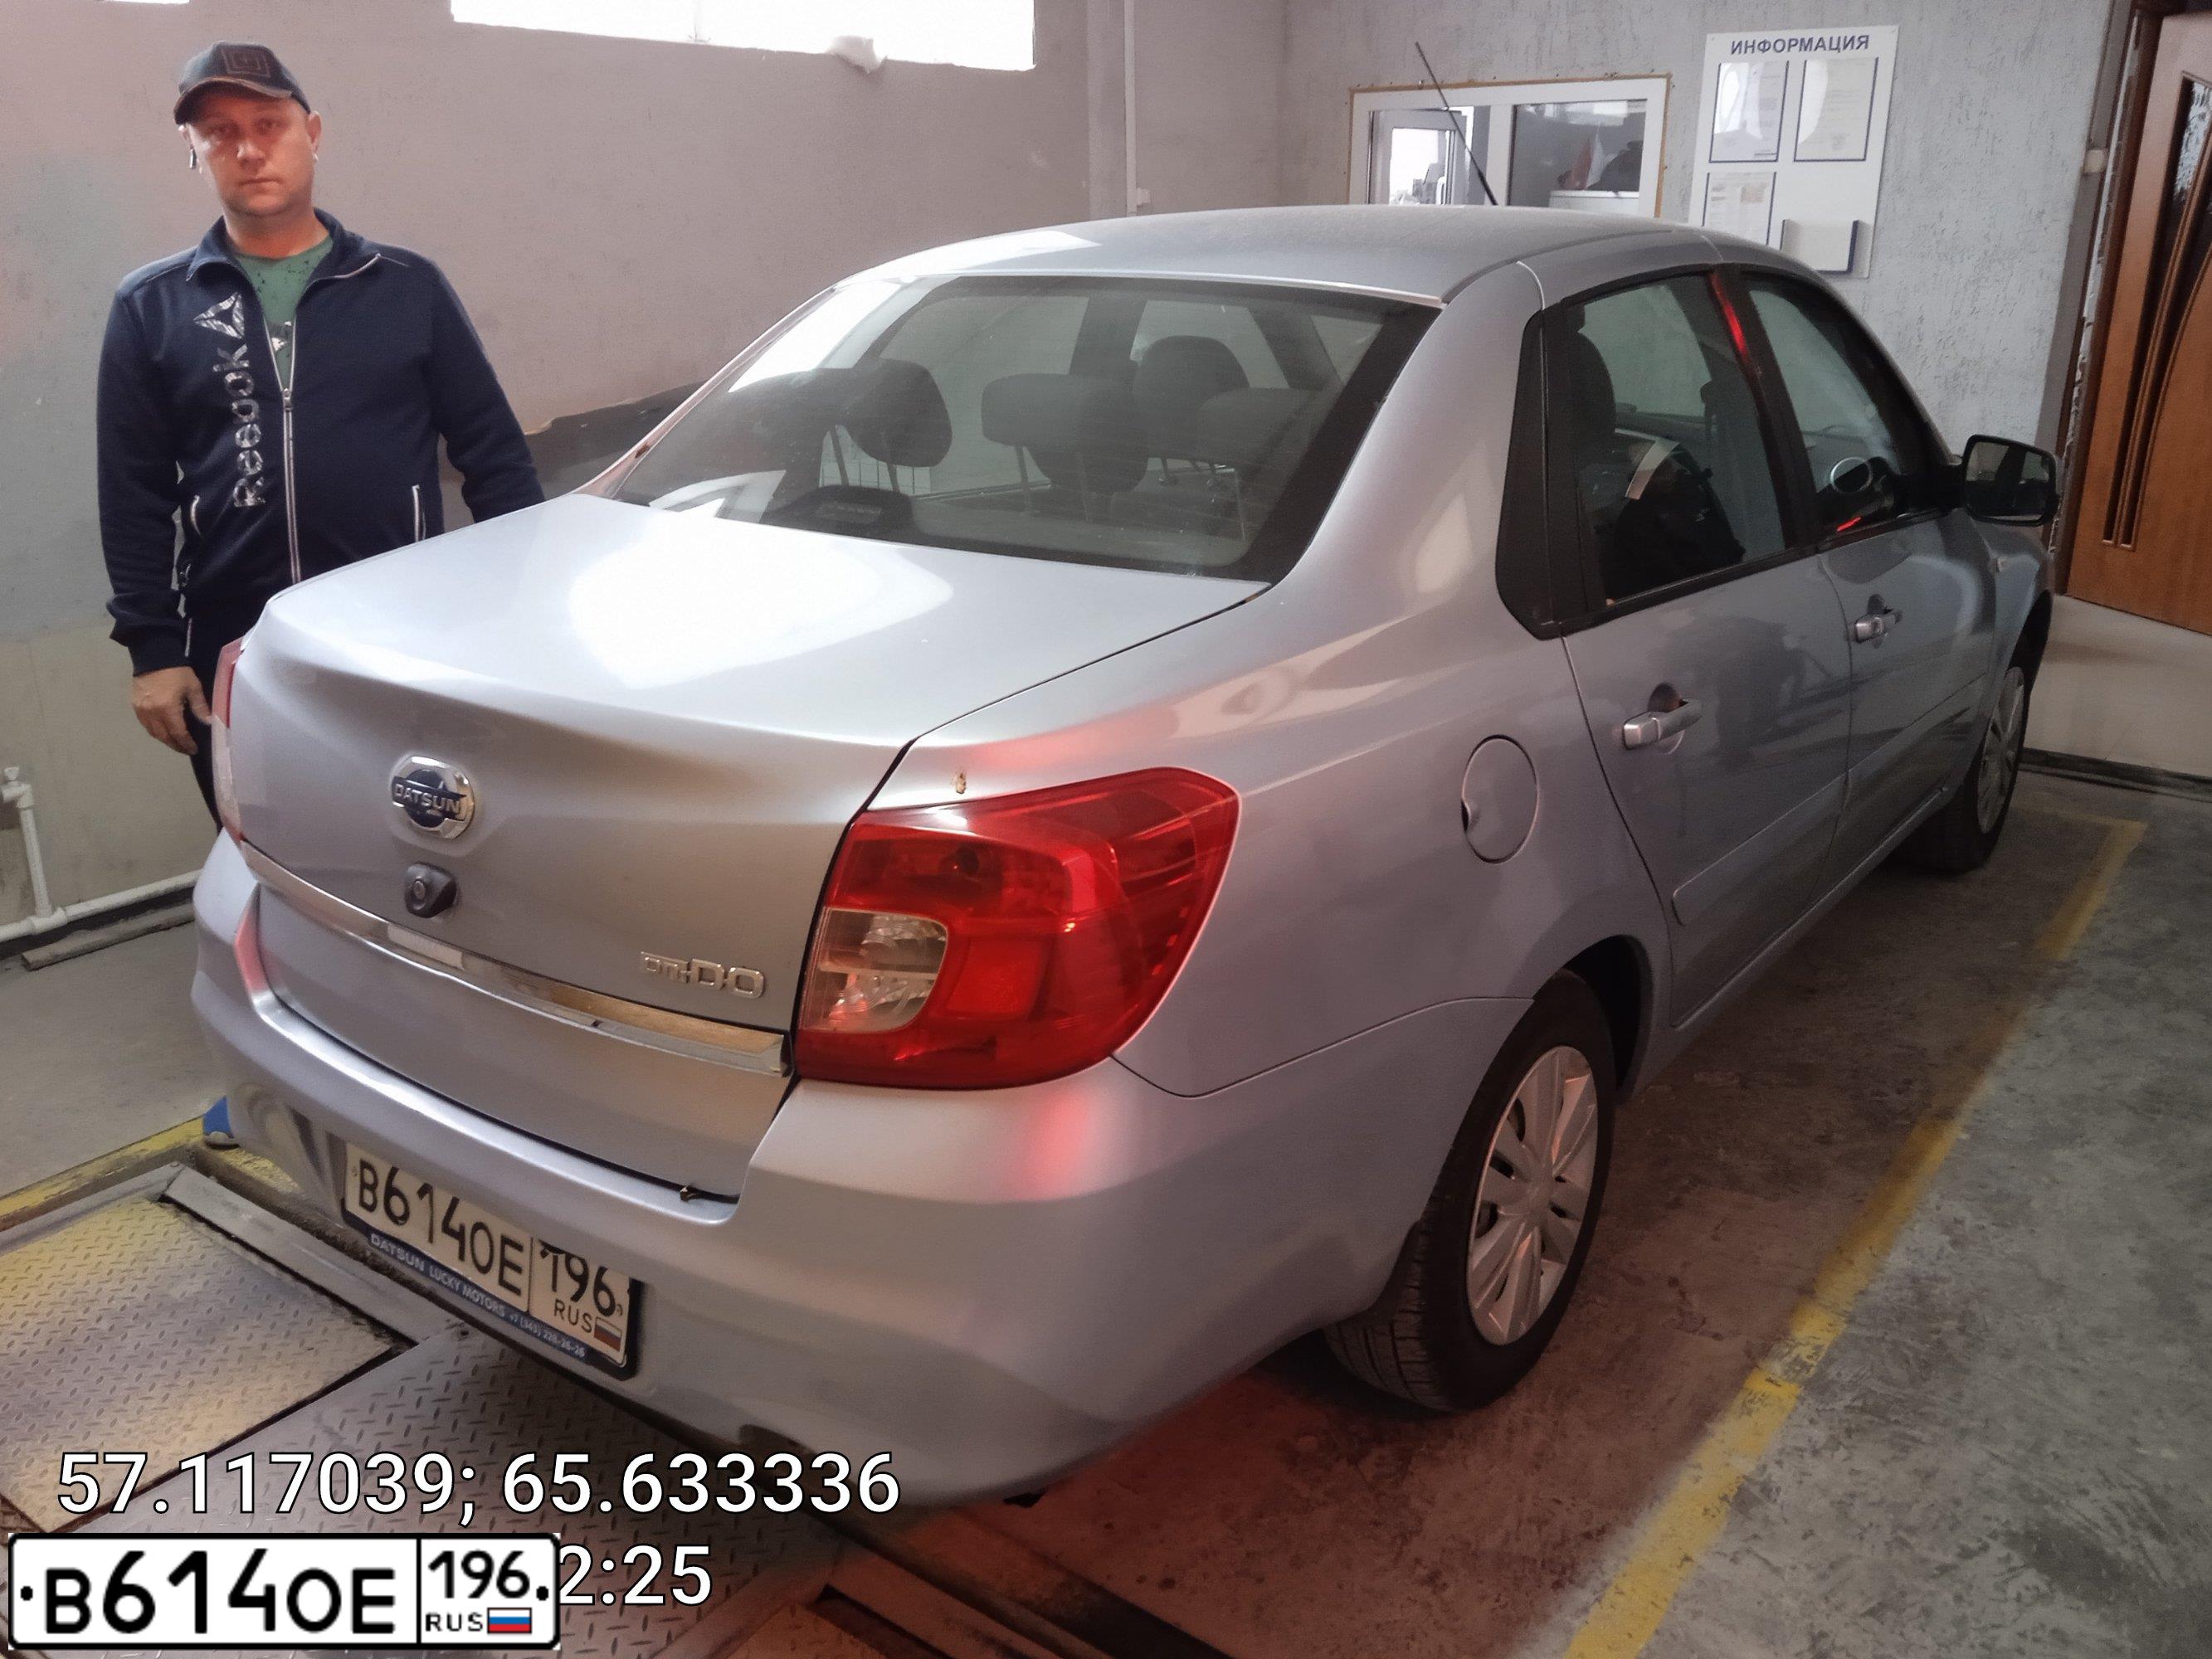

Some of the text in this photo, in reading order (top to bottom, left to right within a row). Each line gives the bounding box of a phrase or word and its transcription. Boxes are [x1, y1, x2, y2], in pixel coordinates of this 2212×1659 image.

[1730, 35, 1870, 55] ИНФОРМАЦИЯ
[212, 343, 266, 508] Reebok
[395, 783, 462, 815] DATSUN
[370, 1233, 425, 1272] DATSUN
[429, 1265, 460, 1292] LUCKY
[461, 1286, 506, 1318] MOTORS
[539, 1244, 616, 1317] 196
[553, 1298, 592, 1333] RUS
